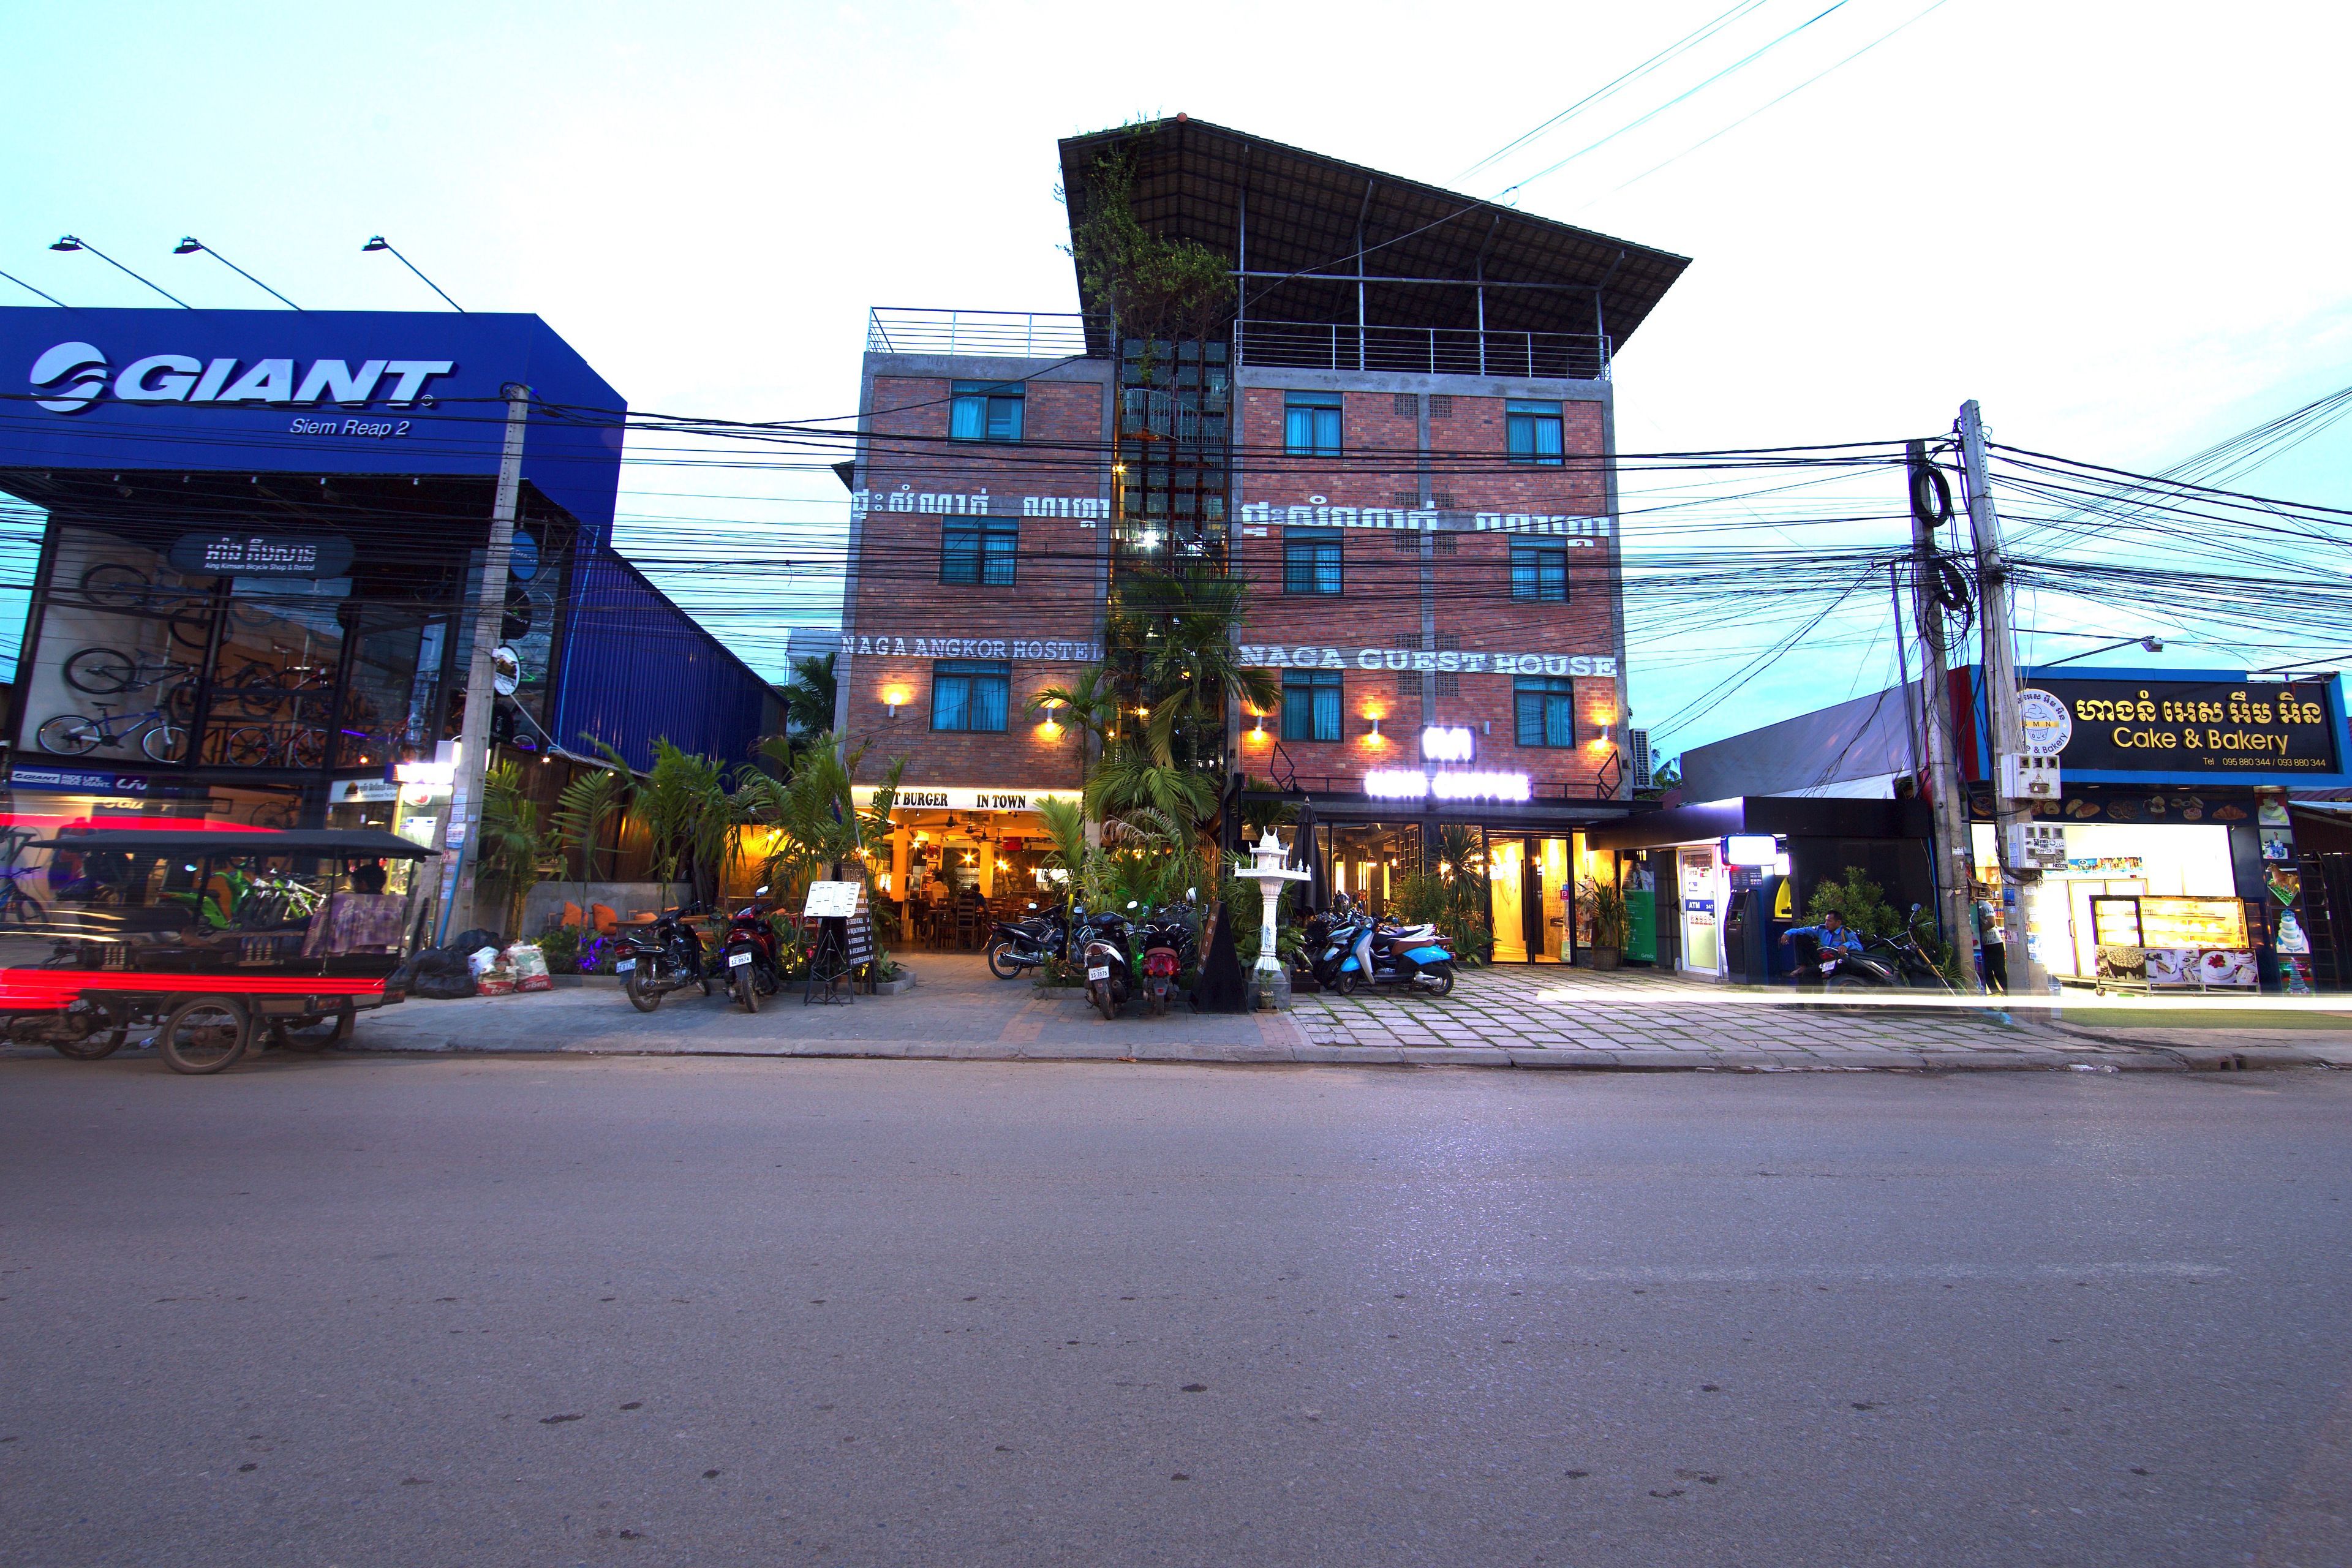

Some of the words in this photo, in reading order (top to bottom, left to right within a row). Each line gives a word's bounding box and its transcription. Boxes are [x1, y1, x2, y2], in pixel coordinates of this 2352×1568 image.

[115, 354, 454, 406] GIANT
[290, 418, 336, 434] Siem
[342, 420, 392, 437] Reap
[395, 421, 410, 435] 2
[841, 636, 907, 656] NAGA
[913, 638, 1007, 658] ANGKOR
[1012, 641, 1103, 661] HOSTEL
[1238, 646, 1348, 669] NAGA
[1357, 649, 1488, 673] GUEST
[1494, 654, 1618, 677] HOUSE
[2042, 733, 2068, 754] Bakery
[2113, 726, 2177, 748] Cake
[2183, 728, 2203, 749] &
[2207, 729, 2288, 755] Bakery
[903, 792, 948, 807] BURGER
[976, 794, 989, 808] IN
[992, 794, 1026, 809] TOWN
